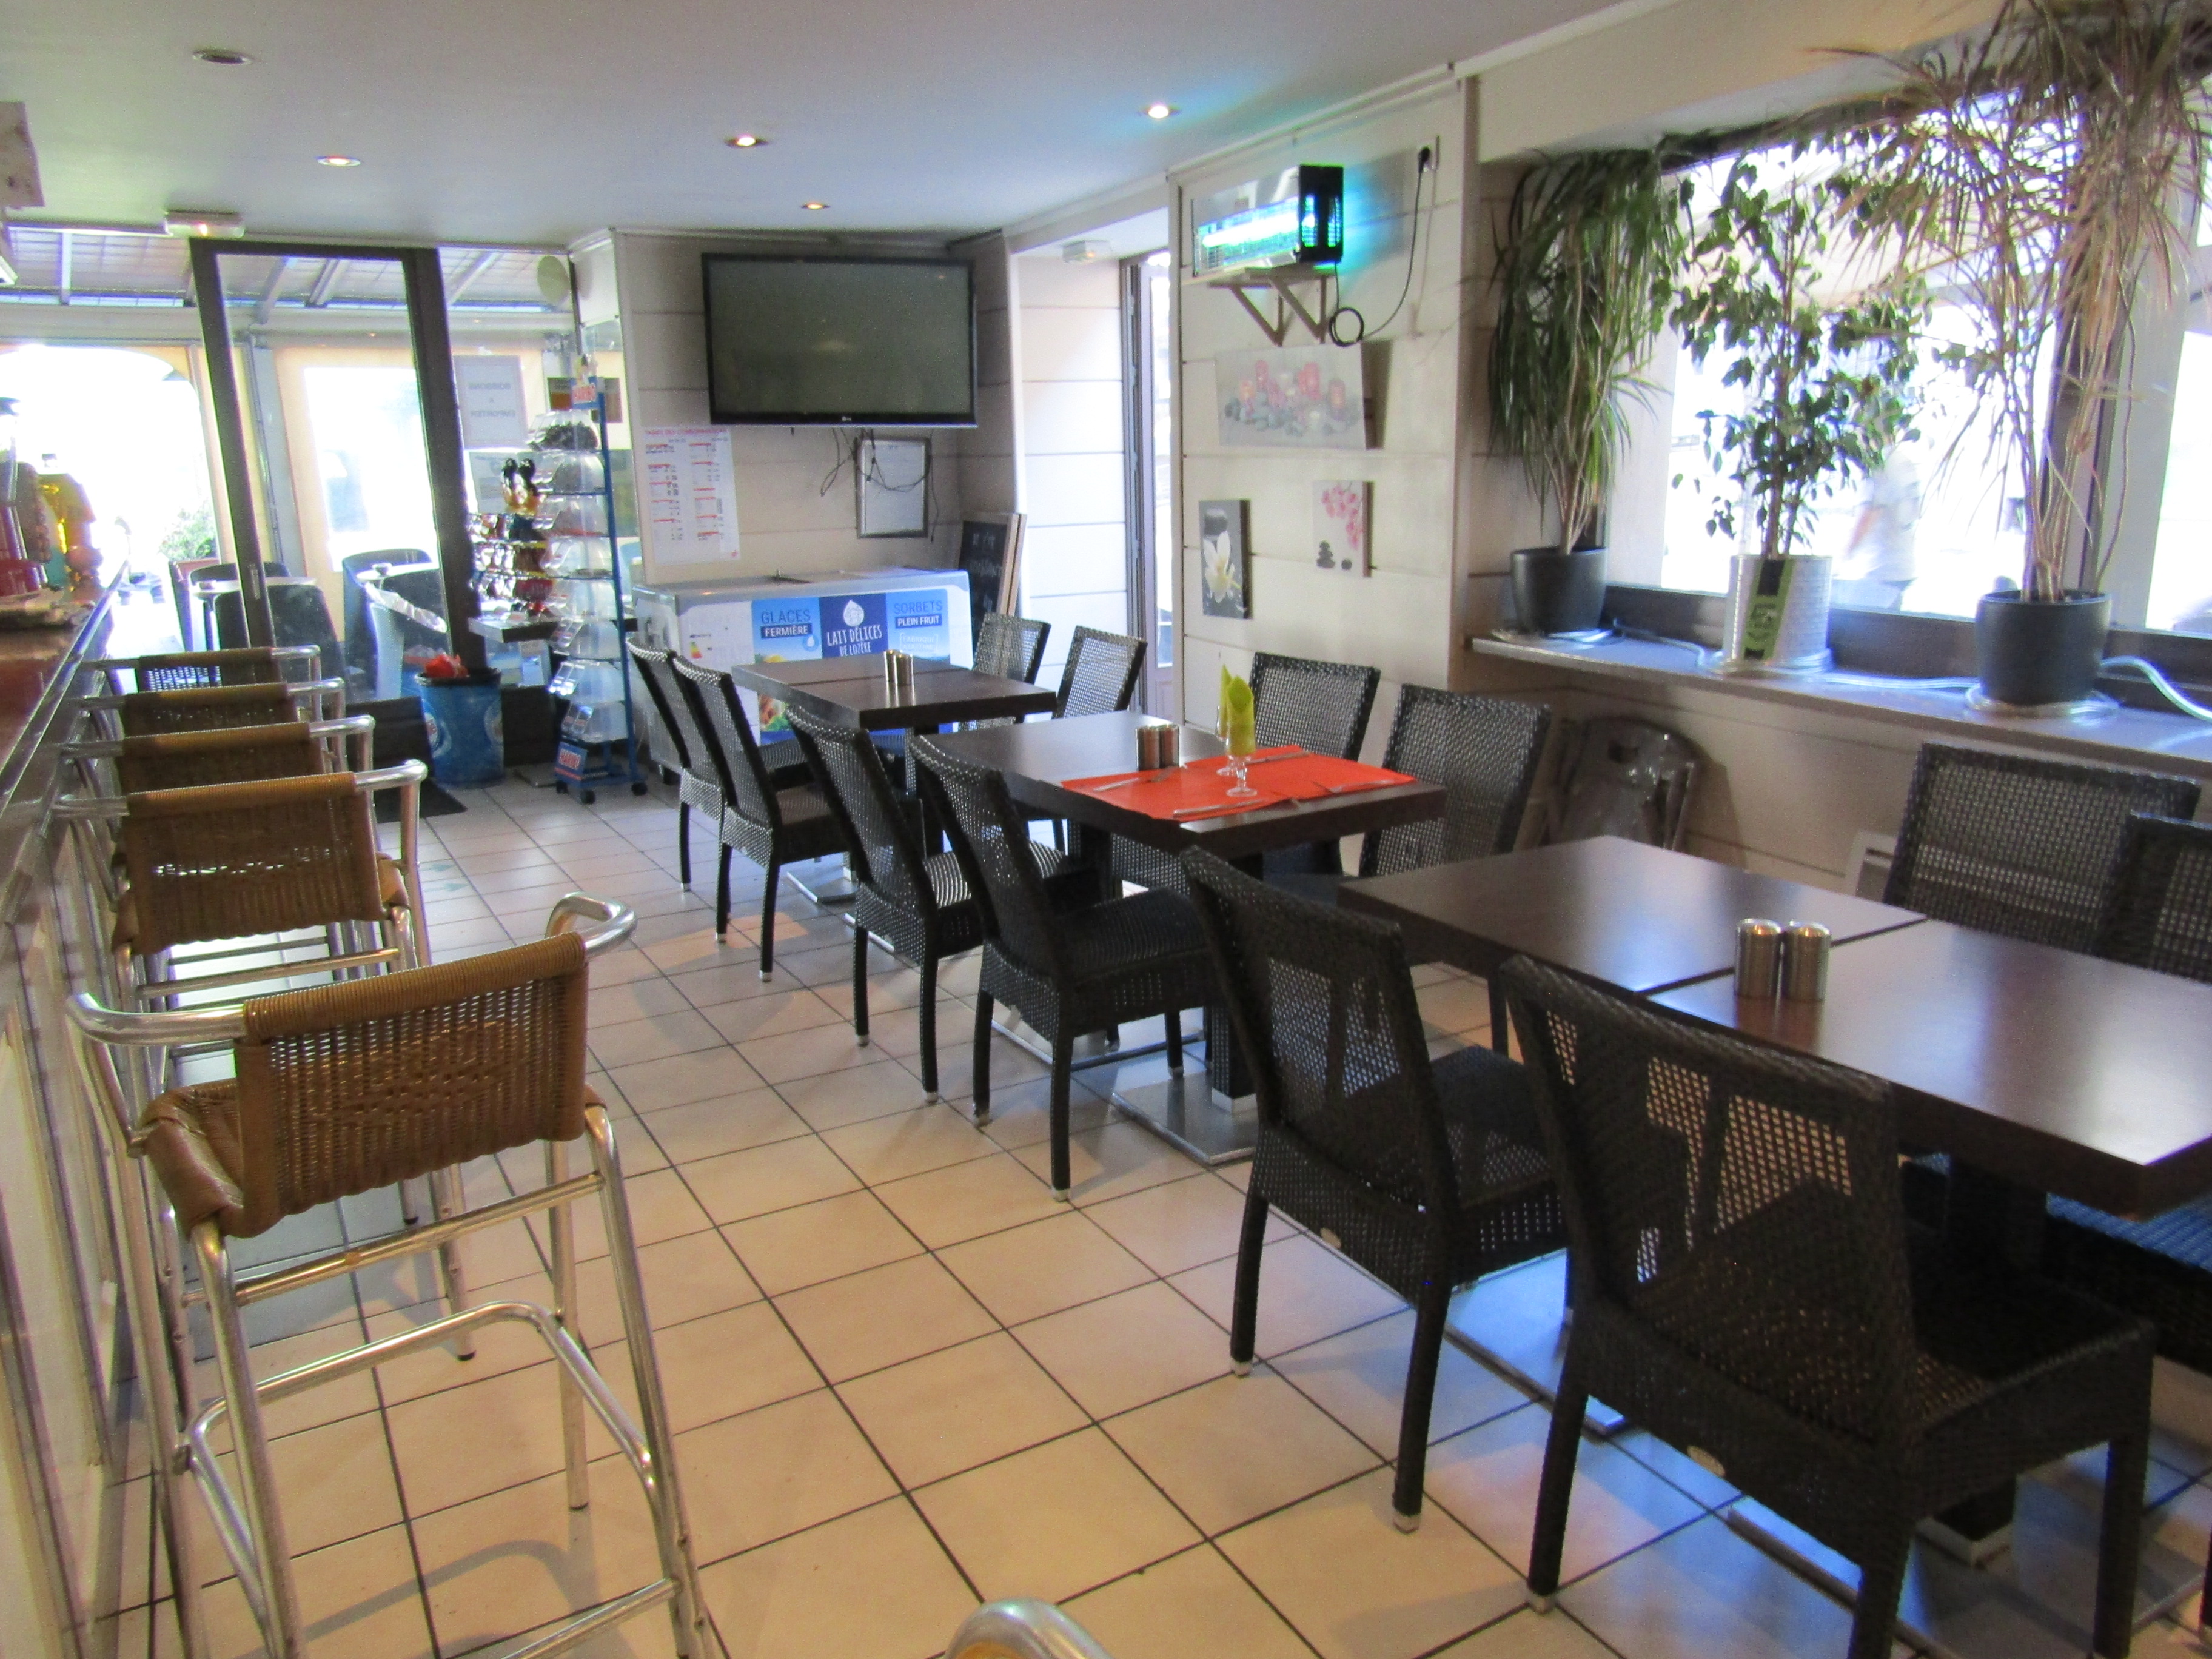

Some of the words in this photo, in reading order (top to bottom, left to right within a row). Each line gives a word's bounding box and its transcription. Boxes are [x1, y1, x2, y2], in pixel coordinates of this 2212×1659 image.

[893, 600, 943, 615] SORBETS
[761, 609, 811, 624] GLACES
[897, 617, 918, 626] PLEIN
[920, 615, 939, 625] FRUIT
[765, 625, 809, 637] FERMIÈRE
[827, 631, 848, 646] LAIT
[850, 625, 882, 642] DÉLICES
[839, 646, 848, 656] DE
[850, 641, 871, 655] LOZÈRE
